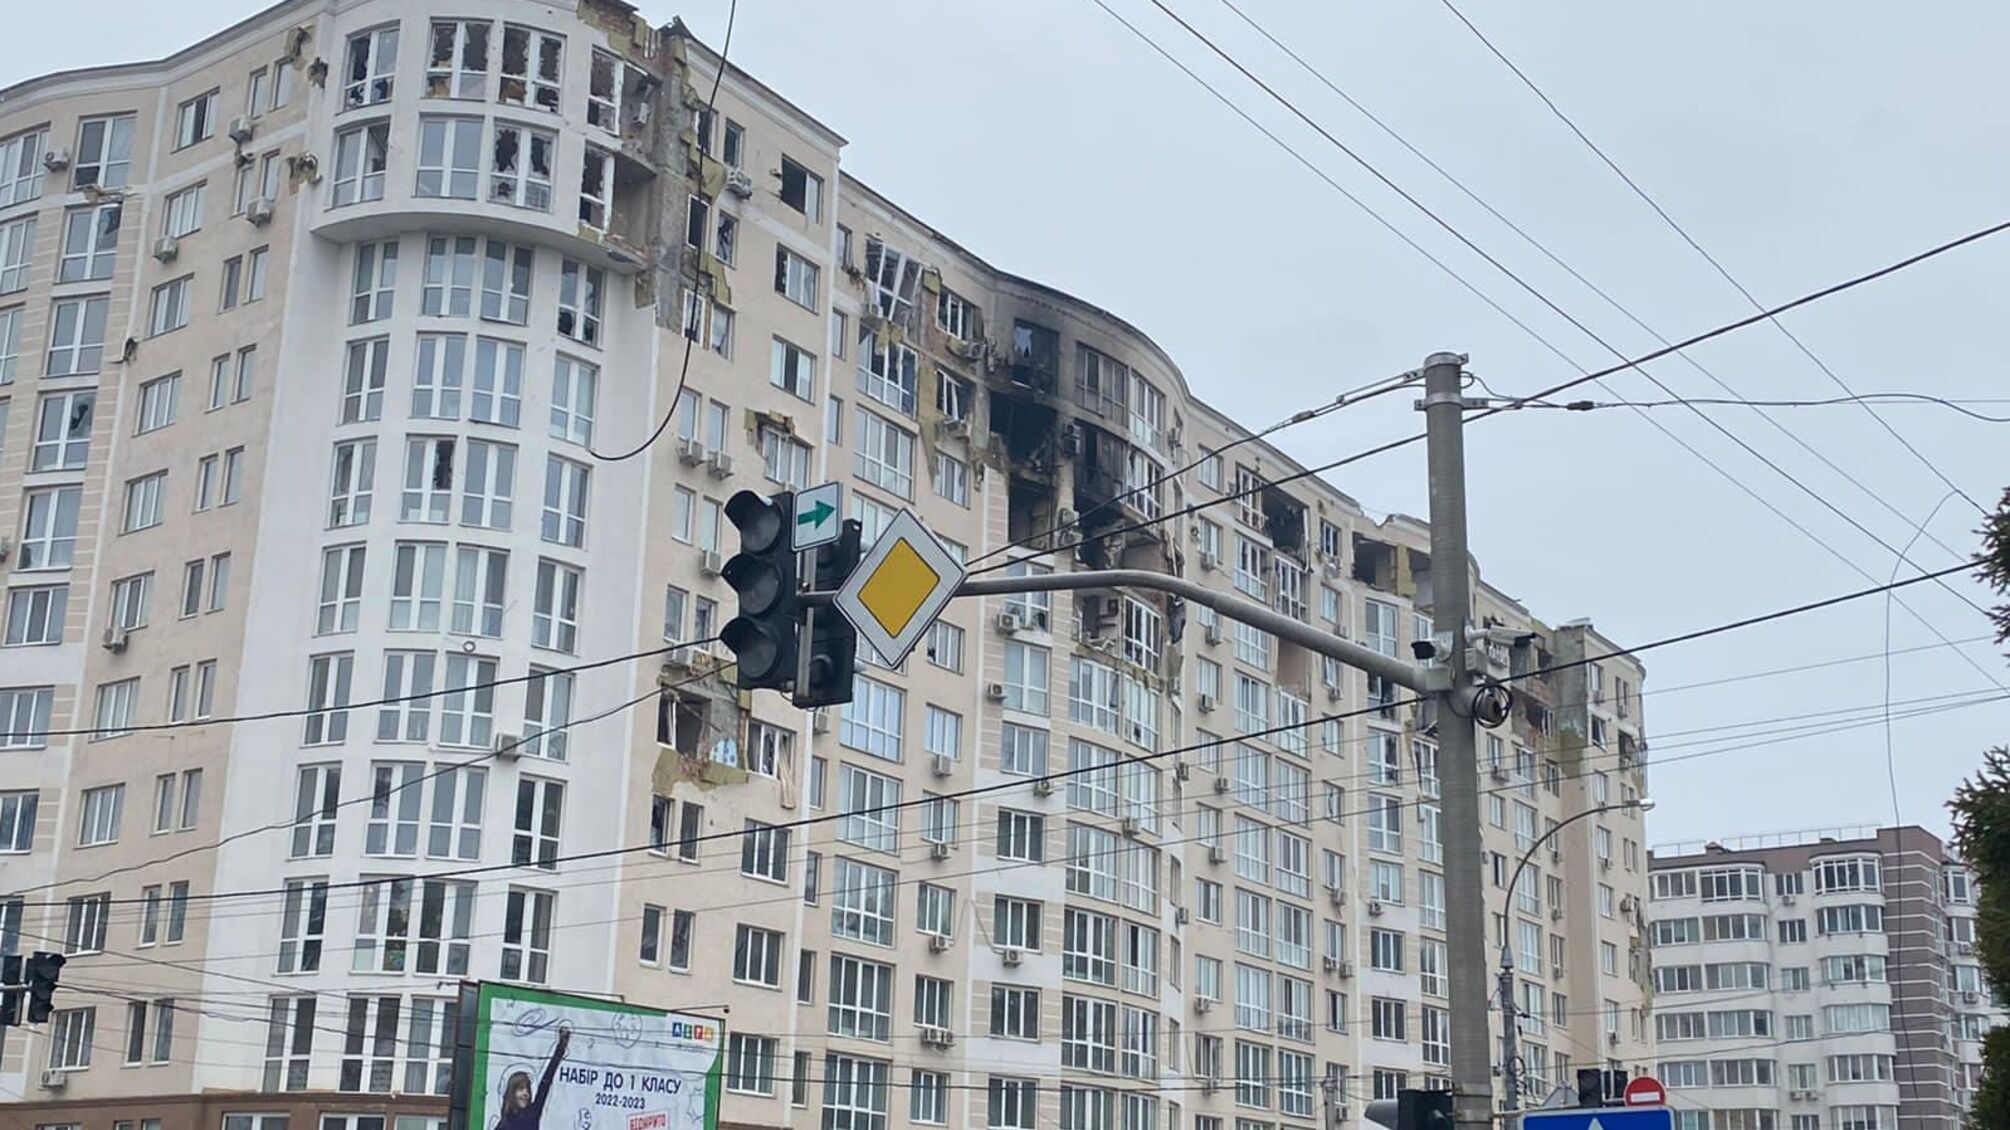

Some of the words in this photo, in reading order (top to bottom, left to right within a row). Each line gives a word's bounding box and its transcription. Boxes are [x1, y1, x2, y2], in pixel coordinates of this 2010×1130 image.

[559, 1066, 598, 1085] НАБІР
[604, 1072, 623, 1092] ДО
[630, 1074, 635, 1090] 1
[642, 1076, 682, 1094] КЛАСУ
[595, 1093, 645, 1109] 2022-2023
